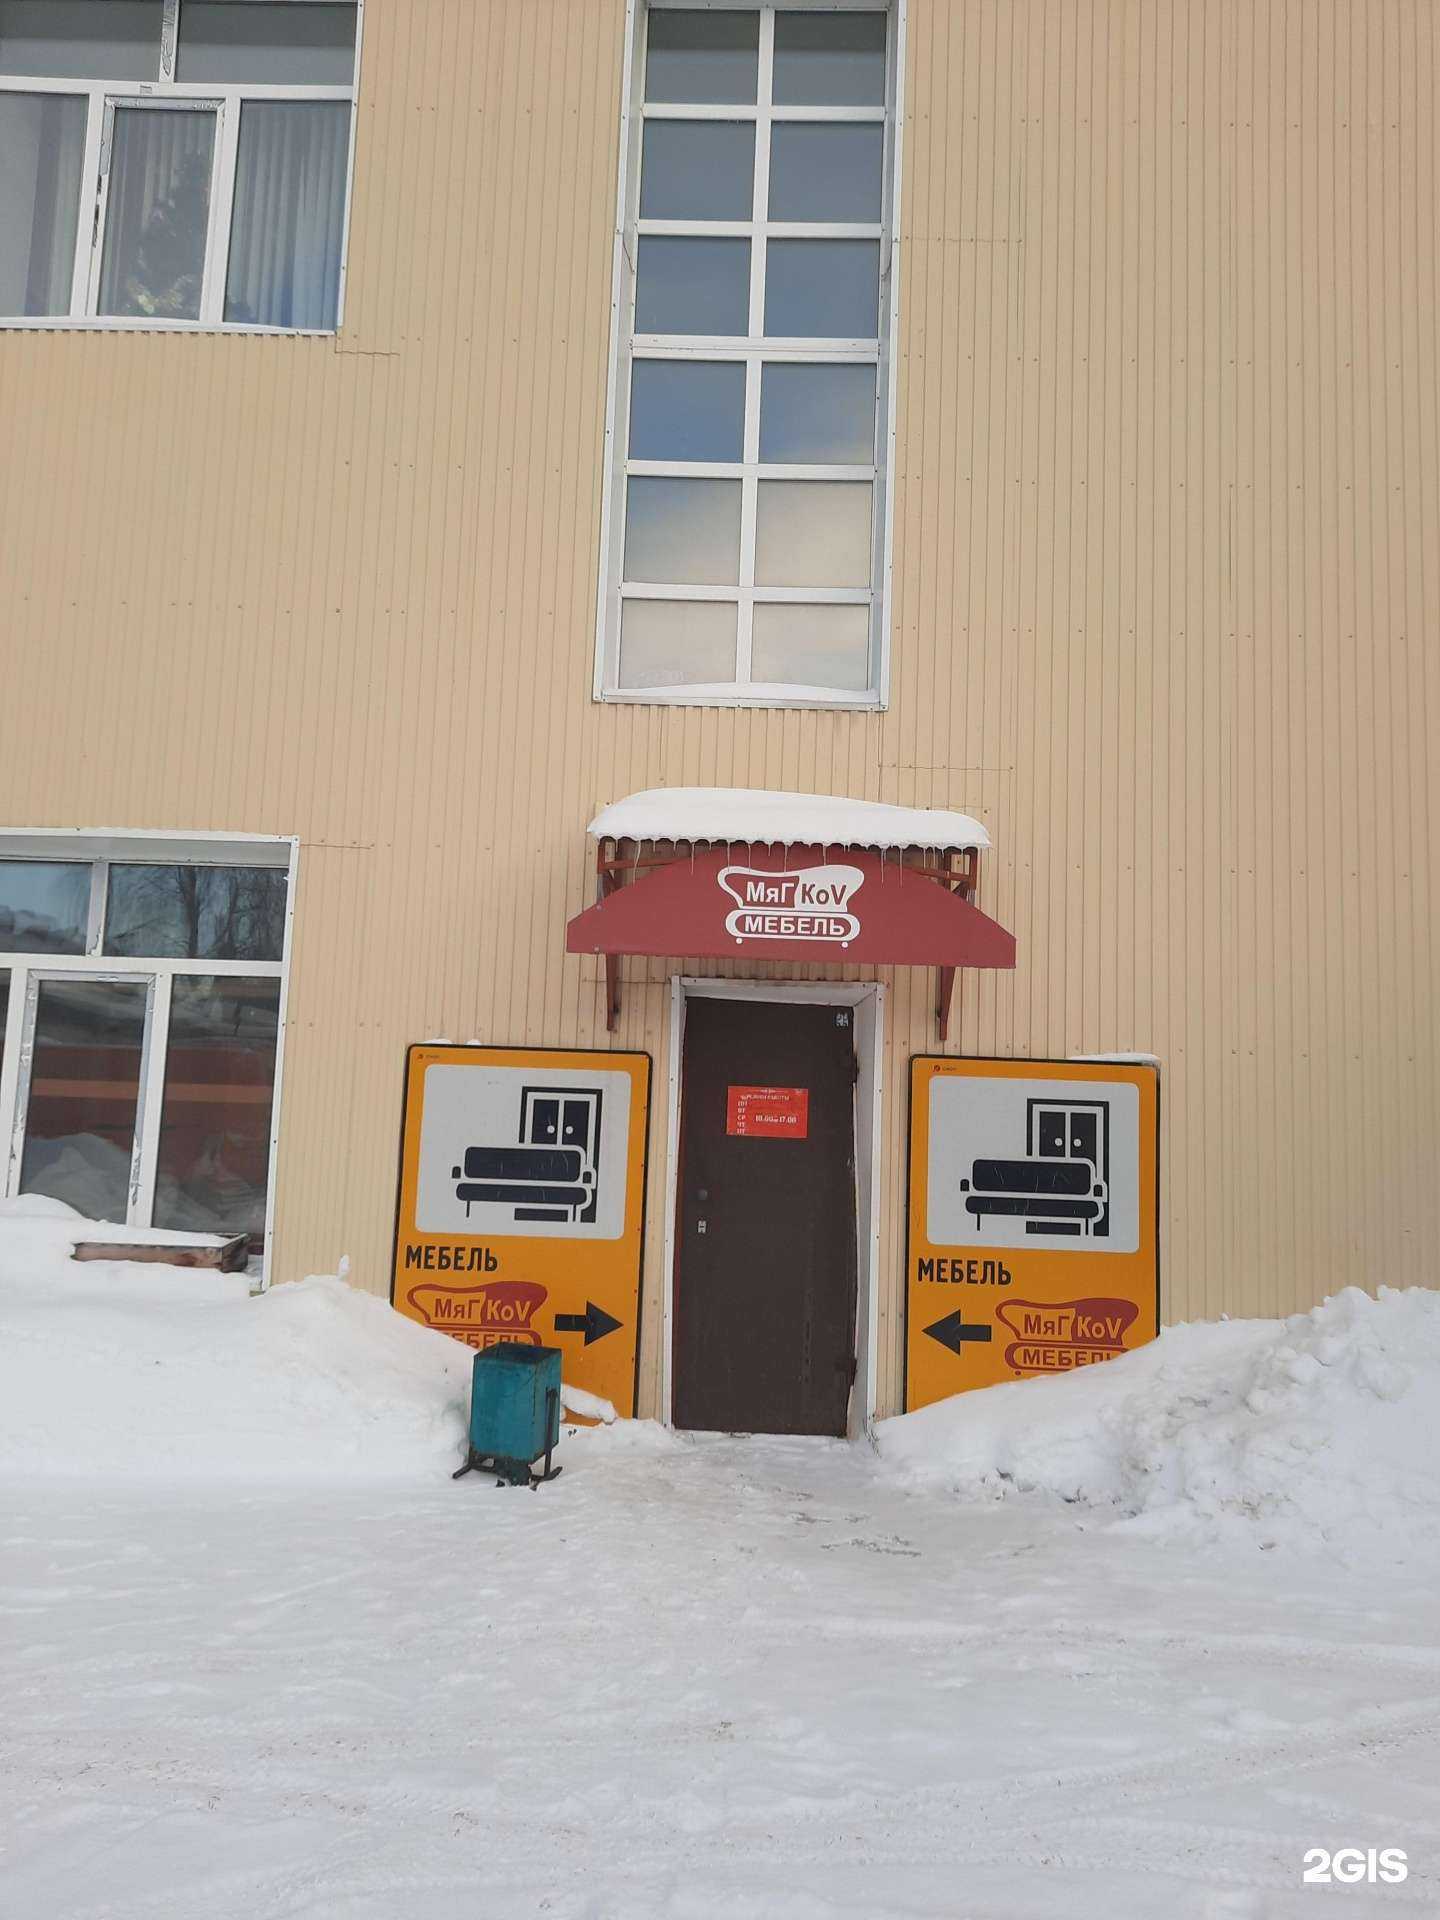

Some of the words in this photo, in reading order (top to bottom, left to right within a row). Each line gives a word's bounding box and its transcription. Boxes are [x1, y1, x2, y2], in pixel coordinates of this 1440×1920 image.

[744, 915, 845, 936] МЕБЕЛЬ
[405, 1245, 498, 1271] МЕБЕЛЬ
[918, 1257, 1011, 1285] МЕБЕЛЬ
